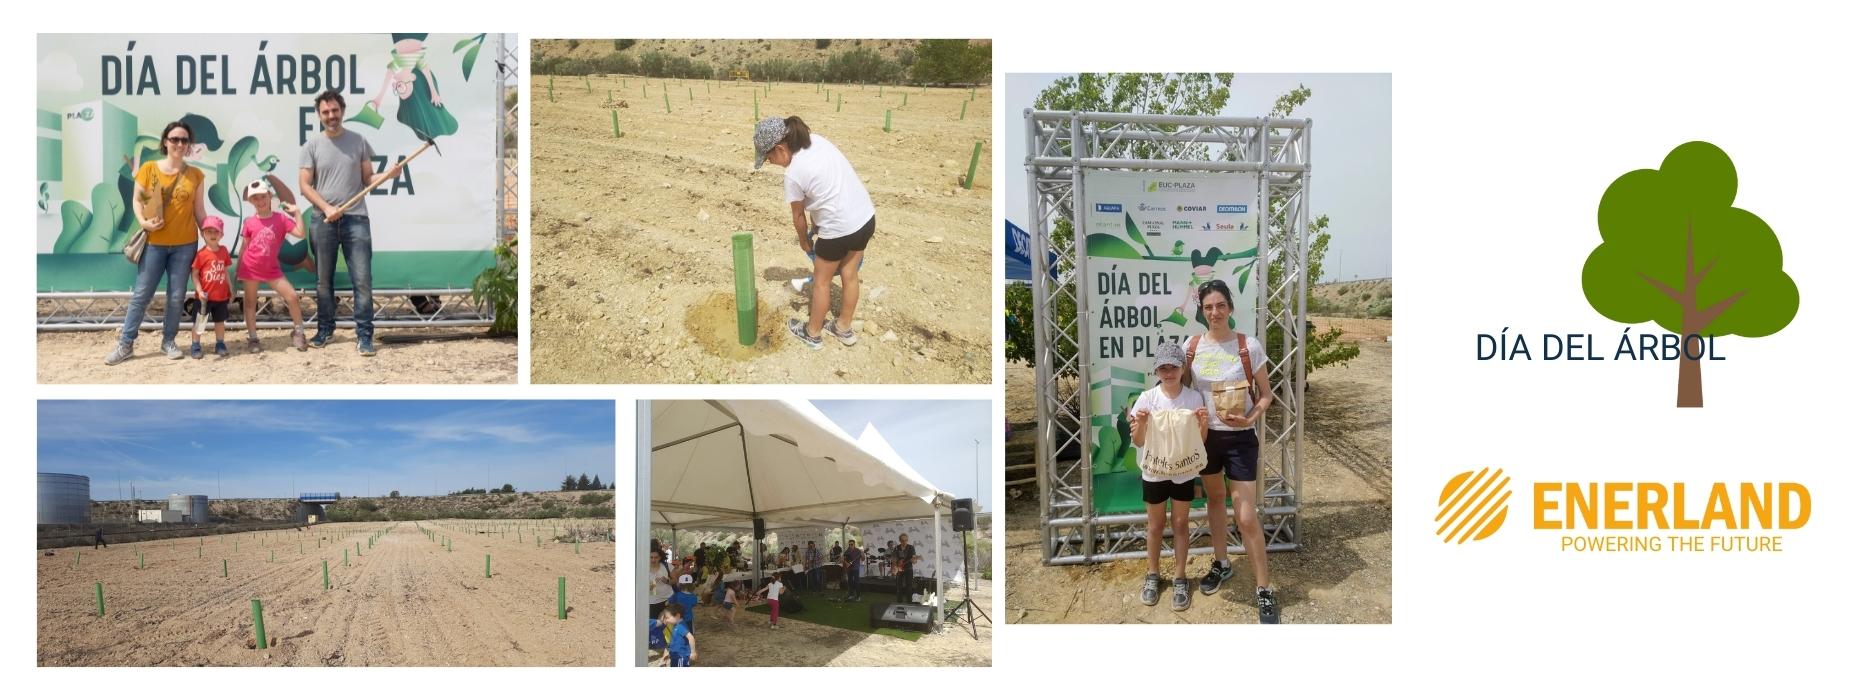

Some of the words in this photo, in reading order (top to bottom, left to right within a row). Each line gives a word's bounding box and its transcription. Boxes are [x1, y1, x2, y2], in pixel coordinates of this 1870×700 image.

[101, 40, 161, 96] DÍA
[176, 54, 237, 96] DEL
[249, 40, 366, 95] ÁRBOL
[205, 270, 226, 285] Dieg
[1098, 265, 1131, 295] DÍA
[1138, 272, 1172, 295] DEL
[1099, 299, 1162, 328] ÁRBOL
[1100, 336, 1124, 359] EN
